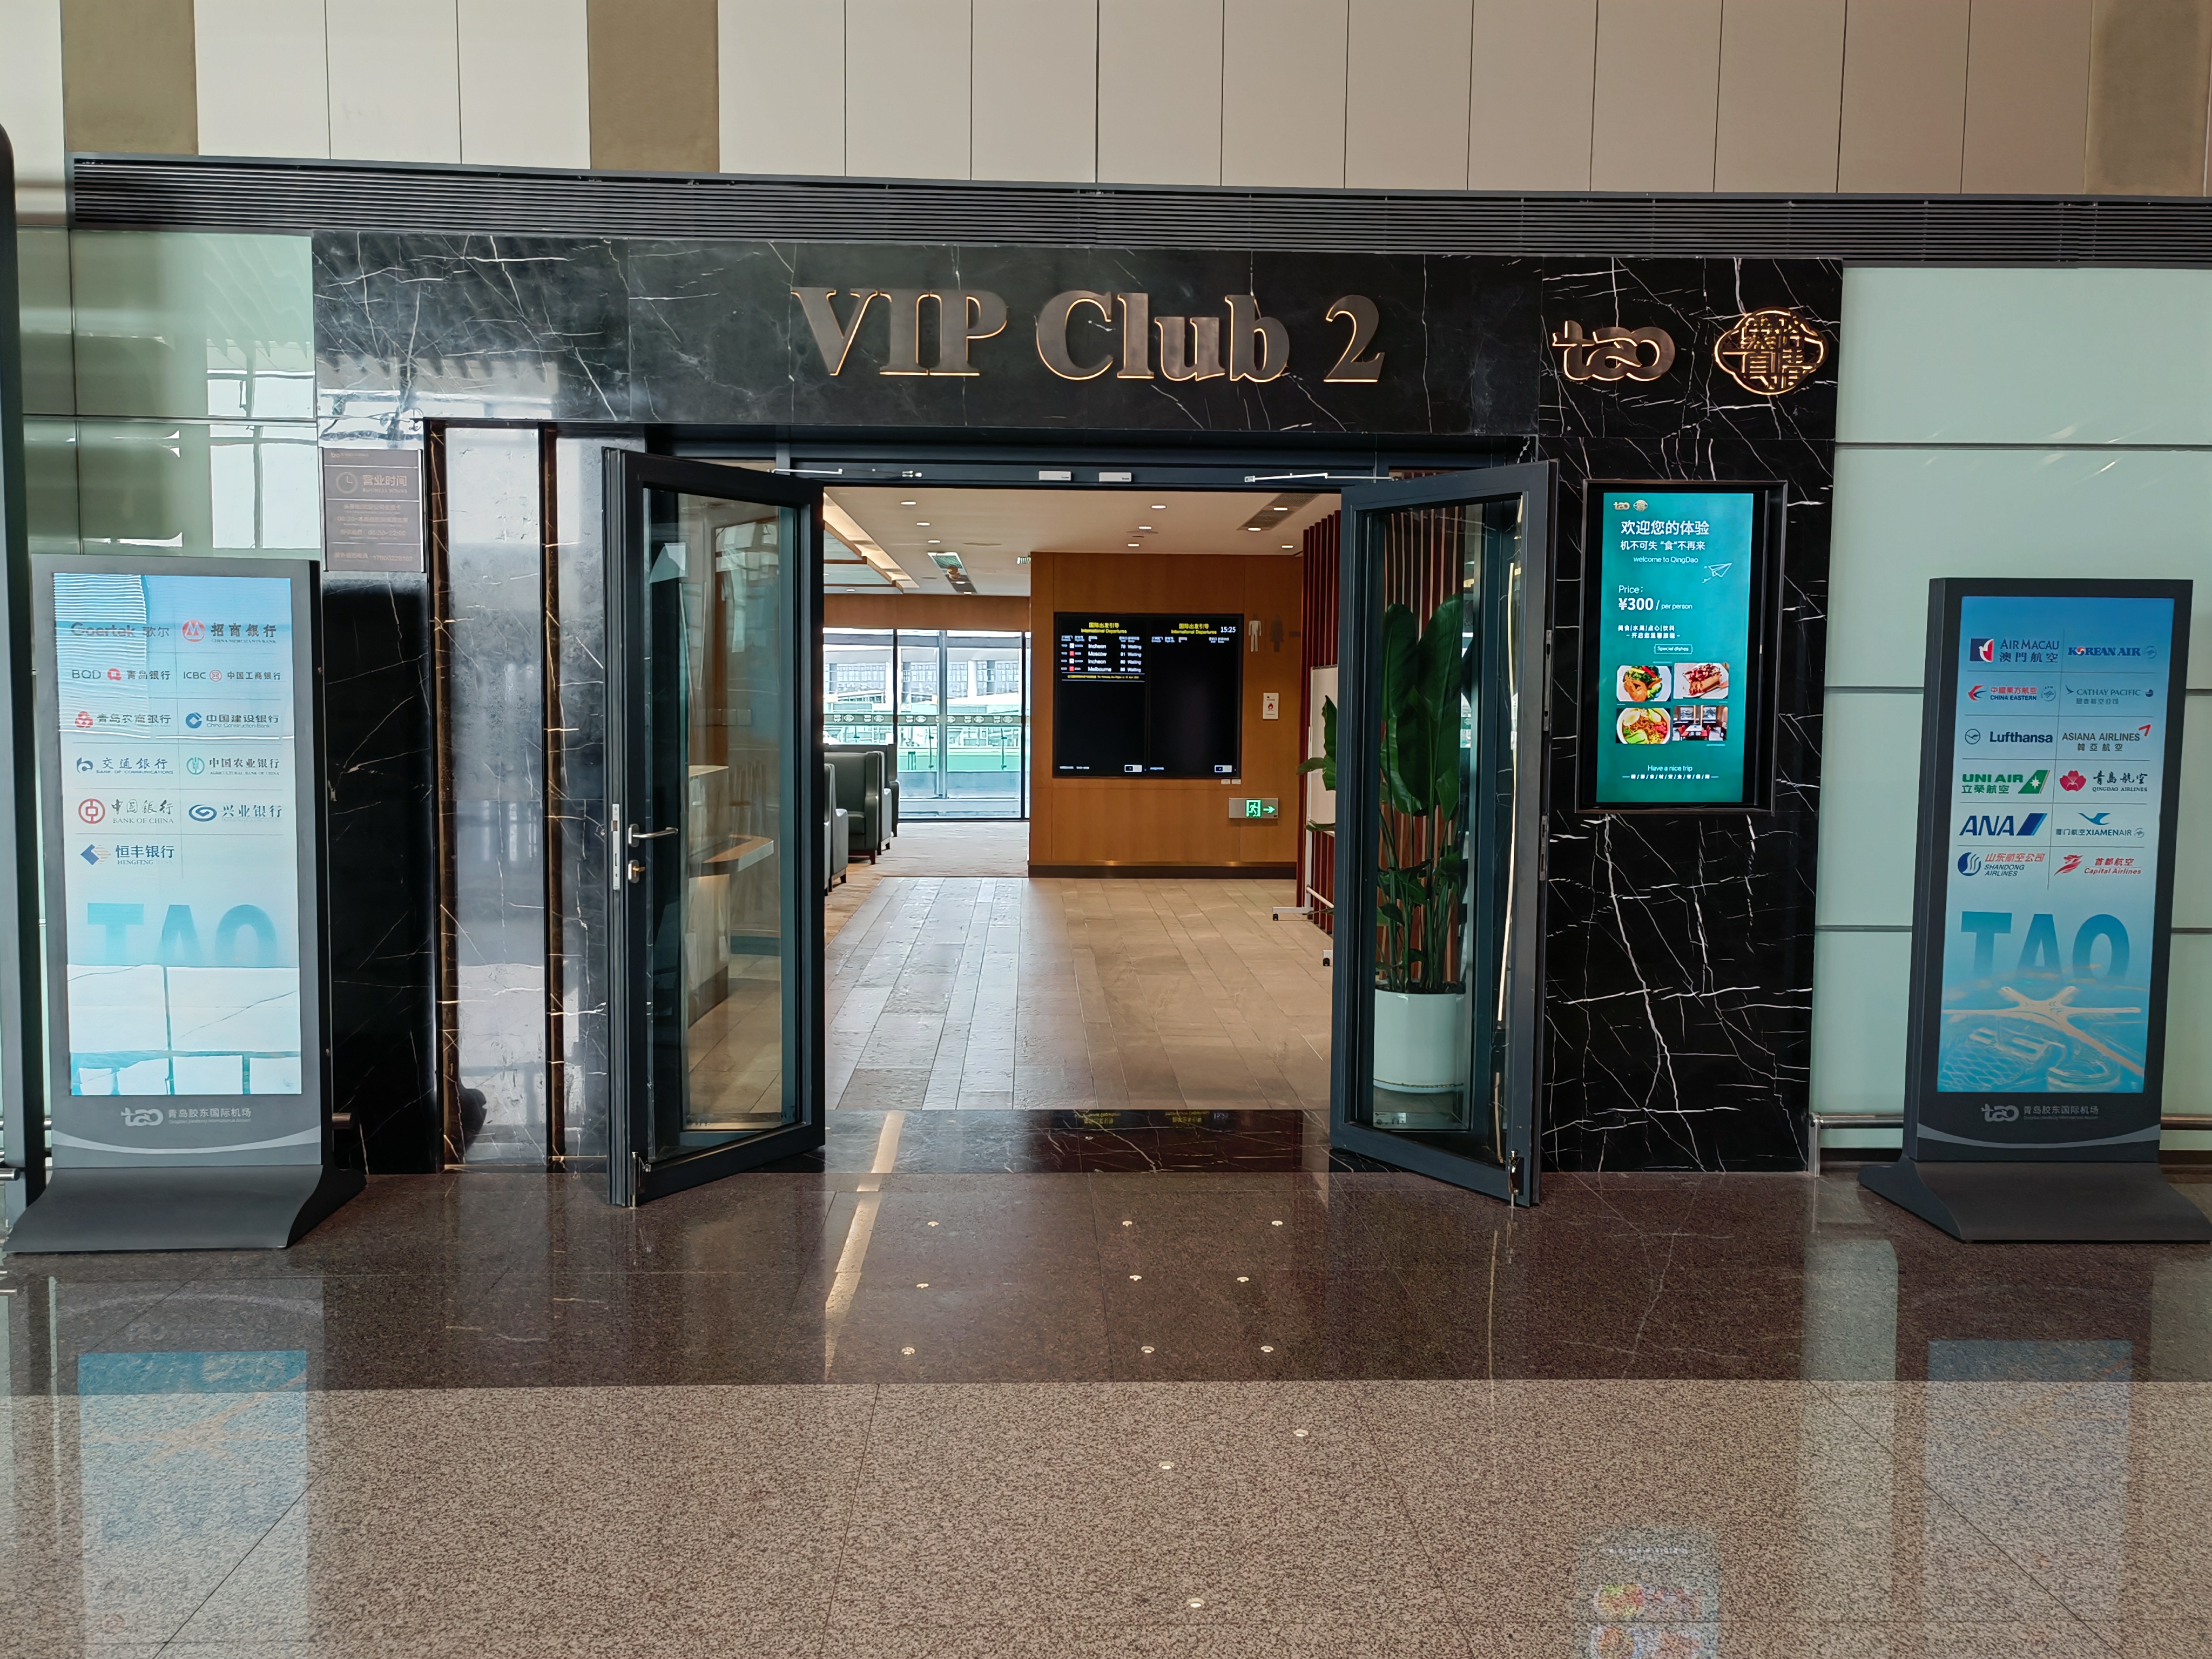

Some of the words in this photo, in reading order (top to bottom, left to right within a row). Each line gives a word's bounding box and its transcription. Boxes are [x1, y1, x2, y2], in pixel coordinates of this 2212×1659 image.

[791, 287, 1008, 376] VIP
[1034, 290, 1291, 382] Club
[1323, 294, 1385, 382] 2
[1552, 320, 1675, 381] tao
[362, 475, 407, 487] 营业时间
[1621, 520, 1709, 536] 欢迎您的体验
[1618, 597, 1654, 611] ¥300
[2000, 639, 2019, 649] AIR
[2021, 639, 2059, 650] MACAU
[2068, 646, 2116, 657] KOREAN
[2117, 648, 2141, 656] AIR
[1999, 652, 2058, 663] 澳門航空
[72, 670, 102, 679] BQD
[126, 670, 171, 680] 青岛银行
[227, 671, 281, 680] 中国工商银行
[206, 714, 279, 723] 中国建设银行
[1990, 731, 2053, 743] Lufthansa
[2062, 732, 2096, 741] ASIANA
[2099, 732, 2140, 741] AIRLINES
[210, 758, 279, 768] 中国农业银行
[1963, 774, 1992, 783] UNI
[1994, 774, 2024, 783] AIR
[221, 805, 282, 818] 兴业银行
[1959, 815, 2014, 836] ANA
[116, 845, 174, 858] 恒丰银行
[1985, 853, 2045, 862] 山东航空公司
[2095, 858, 2134, 866] 首都航空
[87, 902, 279, 967] TAO
[1961, 911, 2130, 982] TAO
[168, 1108, 251, 1118] 青岛胶东国际机场
[1981, 1103, 2019, 1122] tao
[2024, 1106, 2099, 1115] 青岛胶东国际机场
[120, 1107, 164, 1126] tao
